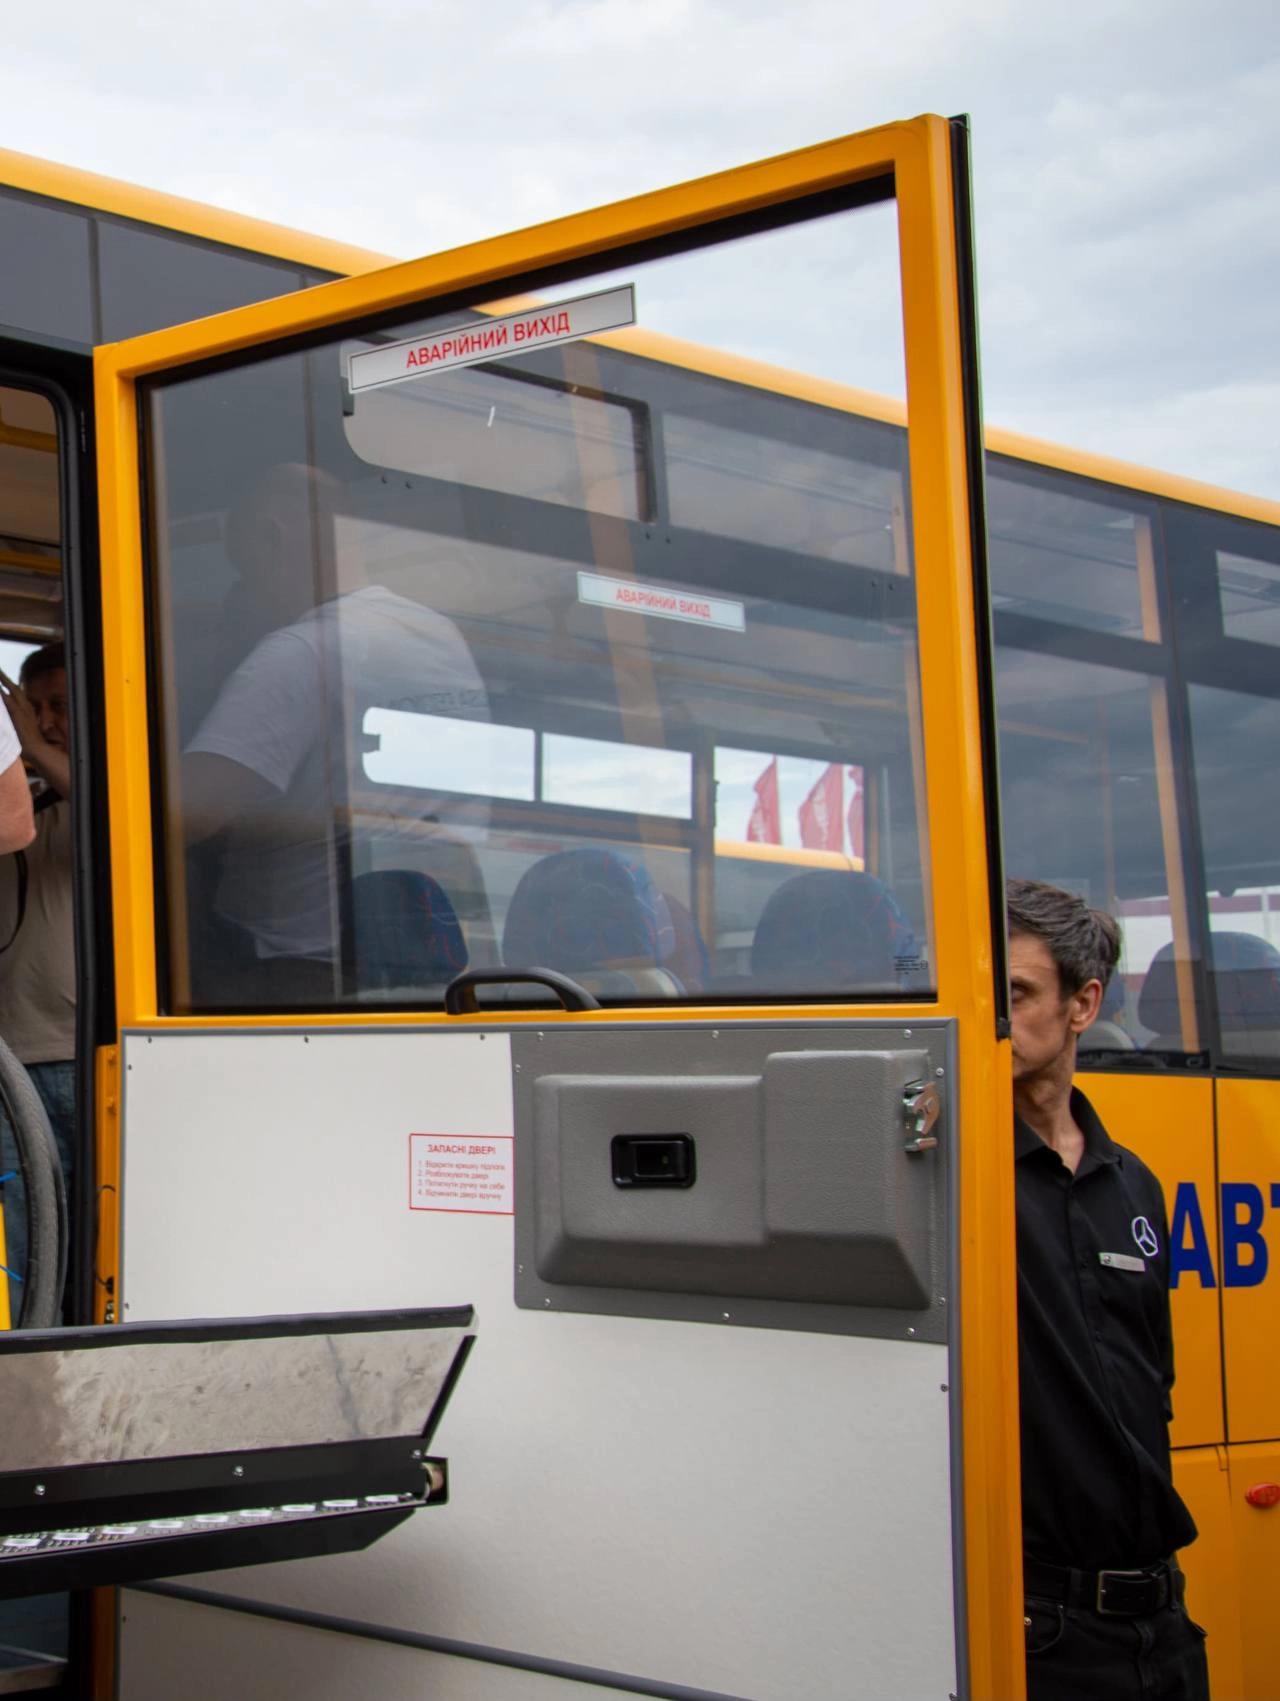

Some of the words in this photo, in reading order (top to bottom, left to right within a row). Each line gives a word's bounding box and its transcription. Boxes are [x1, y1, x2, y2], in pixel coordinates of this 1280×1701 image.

[406, 324, 508, 369] АВАРІЙНИЙ
[513, 312, 571, 343] ВИХІД
[1169, 1182, 1280, 1289] АВ
